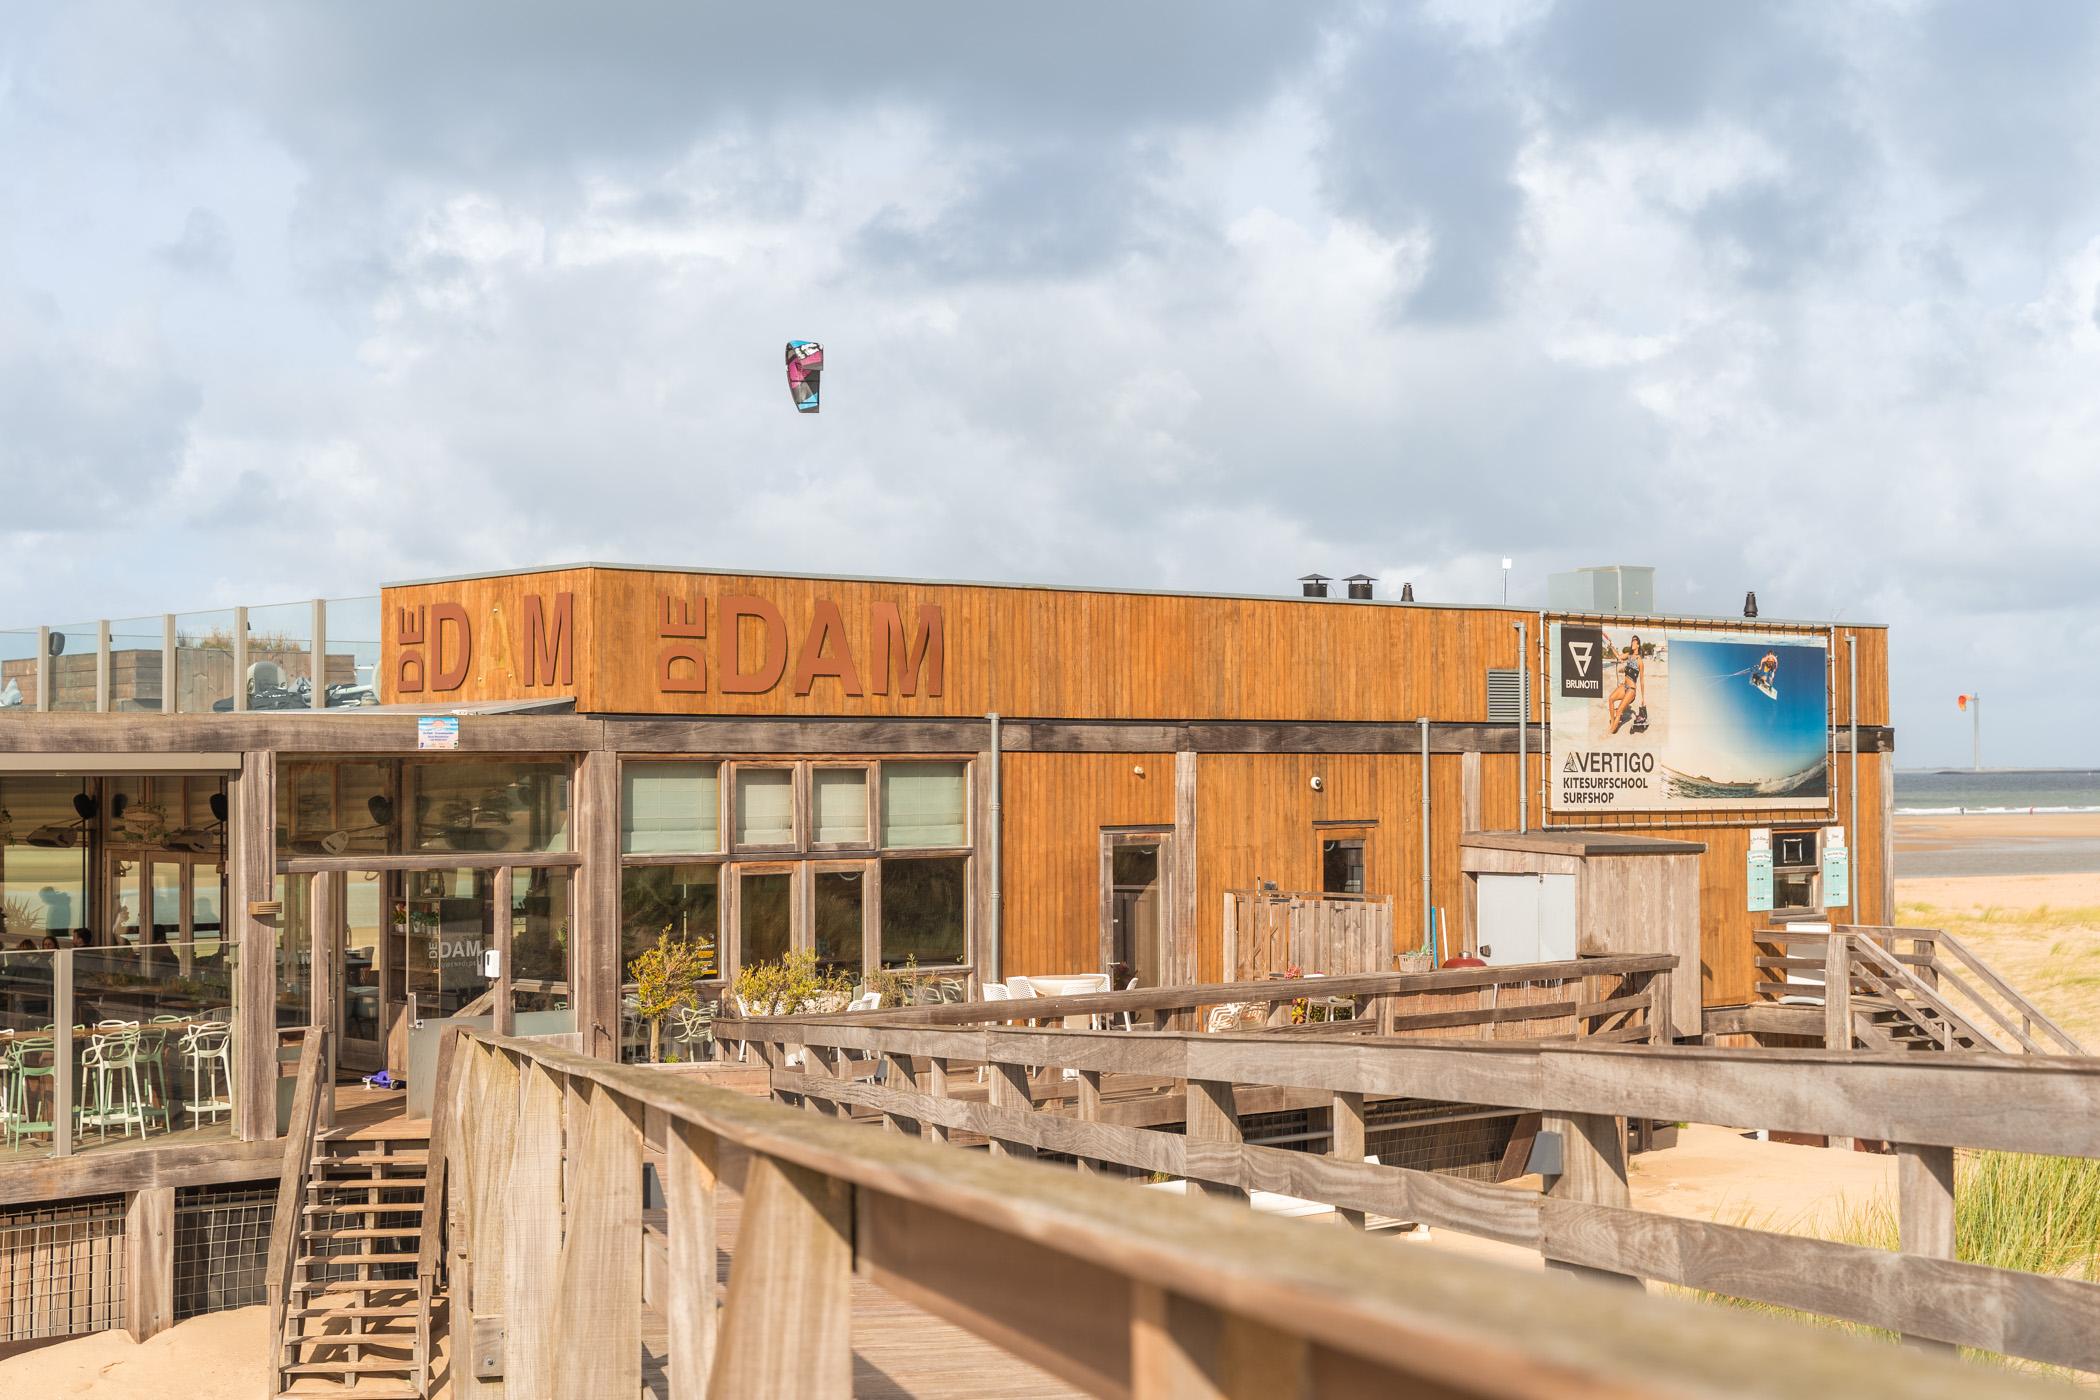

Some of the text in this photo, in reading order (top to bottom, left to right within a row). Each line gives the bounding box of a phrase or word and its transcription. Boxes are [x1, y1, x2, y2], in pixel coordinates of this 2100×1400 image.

[398, 604, 425, 693] DE
[657, 593, 944, 697] DE DAM
[1565, 679, 1599, 690] BRUNOTTI
[1575, 752, 1654, 773] VERTIGO
[1563, 777, 1649, 789] KITESURFSCHOOL
[1563, 792, 1615, 804] SURFSHOP
[428, 940, 482, 959] DE DAM
